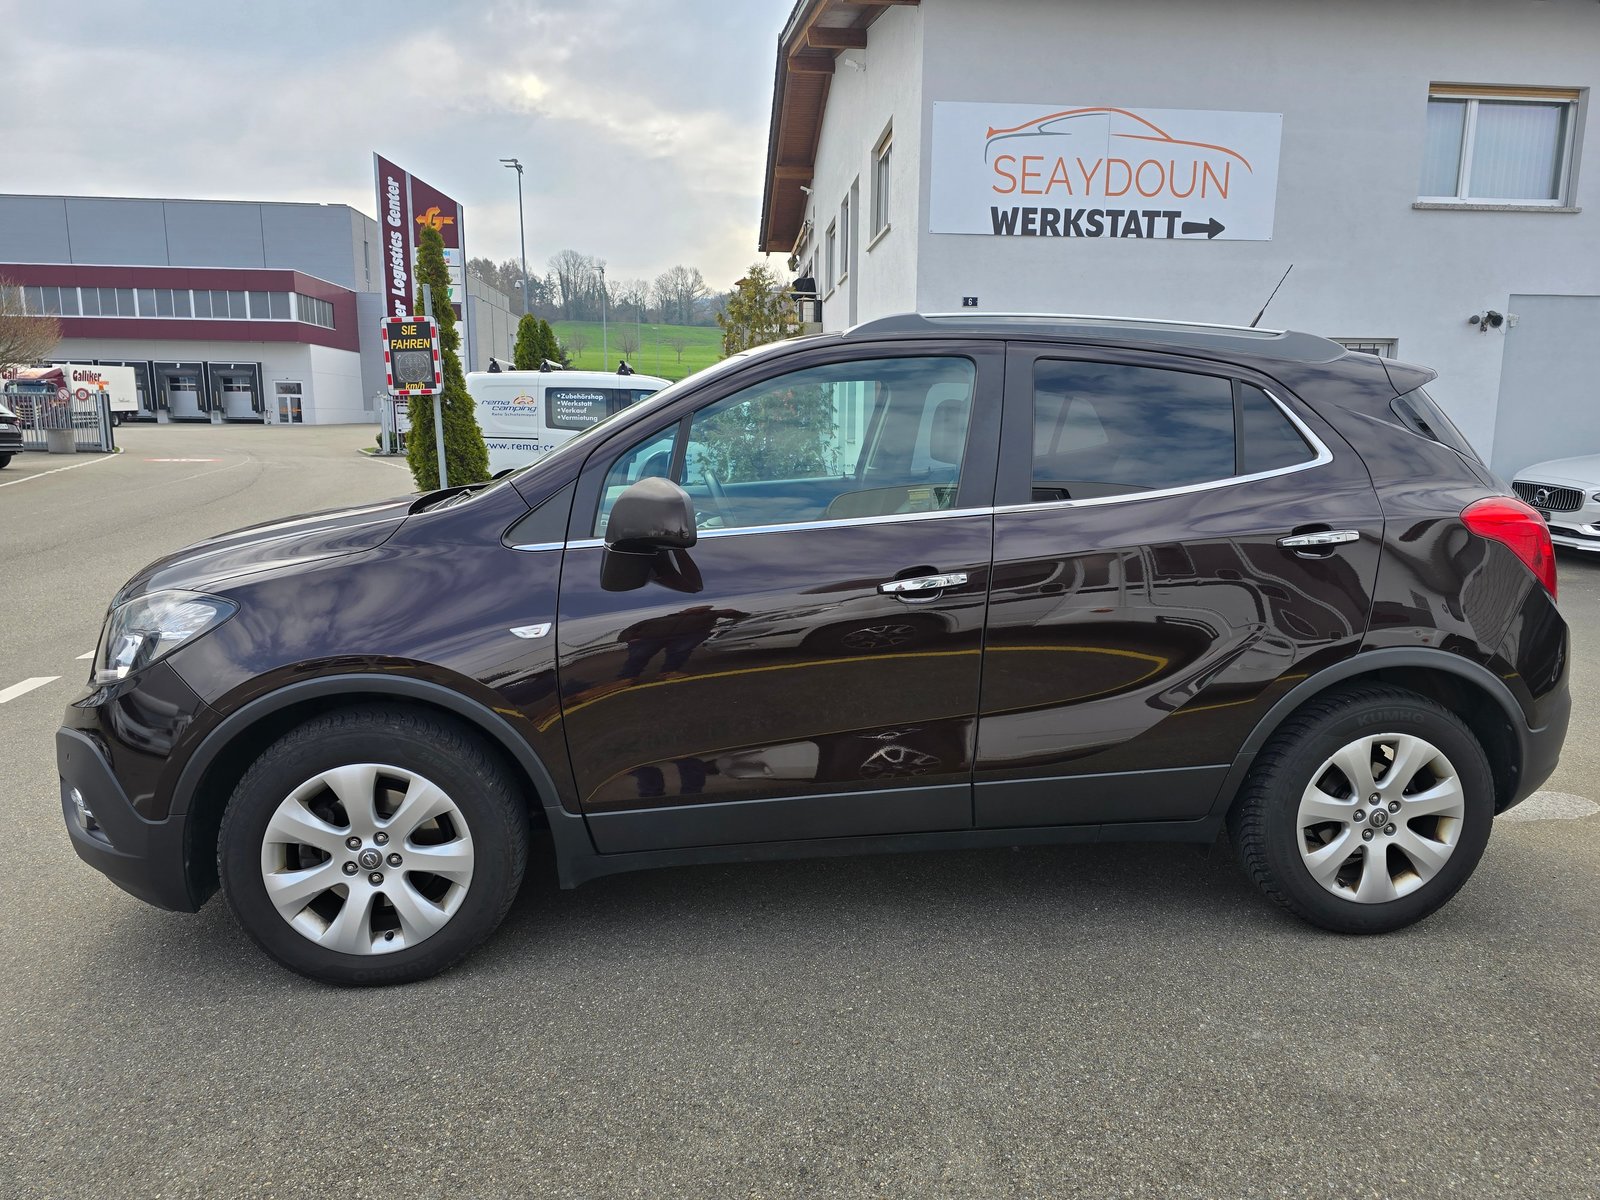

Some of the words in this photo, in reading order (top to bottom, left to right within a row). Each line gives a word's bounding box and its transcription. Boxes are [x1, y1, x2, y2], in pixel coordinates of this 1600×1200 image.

[992, 154, 1230, 200] SEAYDOUN
[386, 176, 402, 227] Center
[990, 206, 1182, 239] WERKSTATT
[389, 231, 407, 297] Logistics
[401, 325, 417, 336] SIE
[390, 338, 431, 350] FAHREN
[73, 370, 102, 382] Galliker
[560, 393, 604, 401] Zubehörshop
[492, 405, 537, 413] camping
